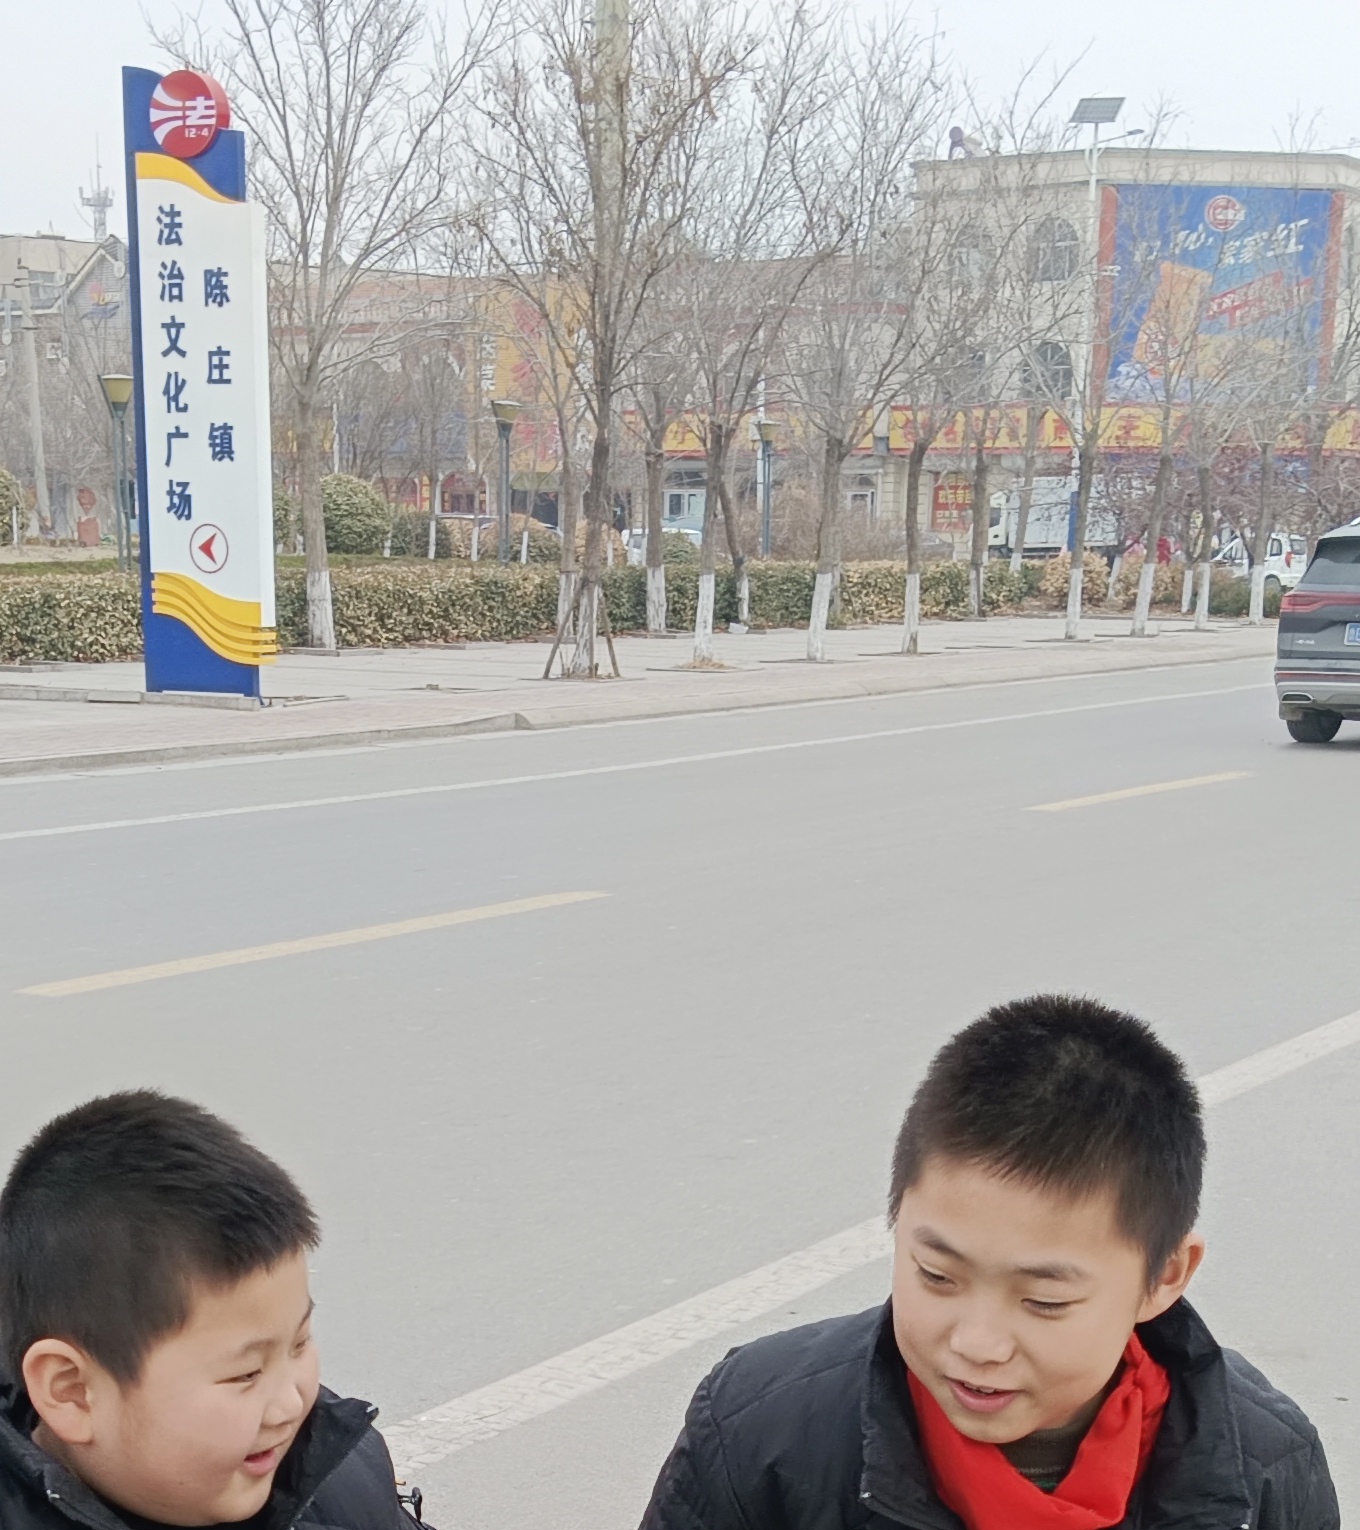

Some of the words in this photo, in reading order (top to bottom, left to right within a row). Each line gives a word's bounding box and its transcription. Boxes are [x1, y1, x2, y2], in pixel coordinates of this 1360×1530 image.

[155, 203, 192, 521] 法治文化广场
[203, 267, 235, 462] 陈庄镇
